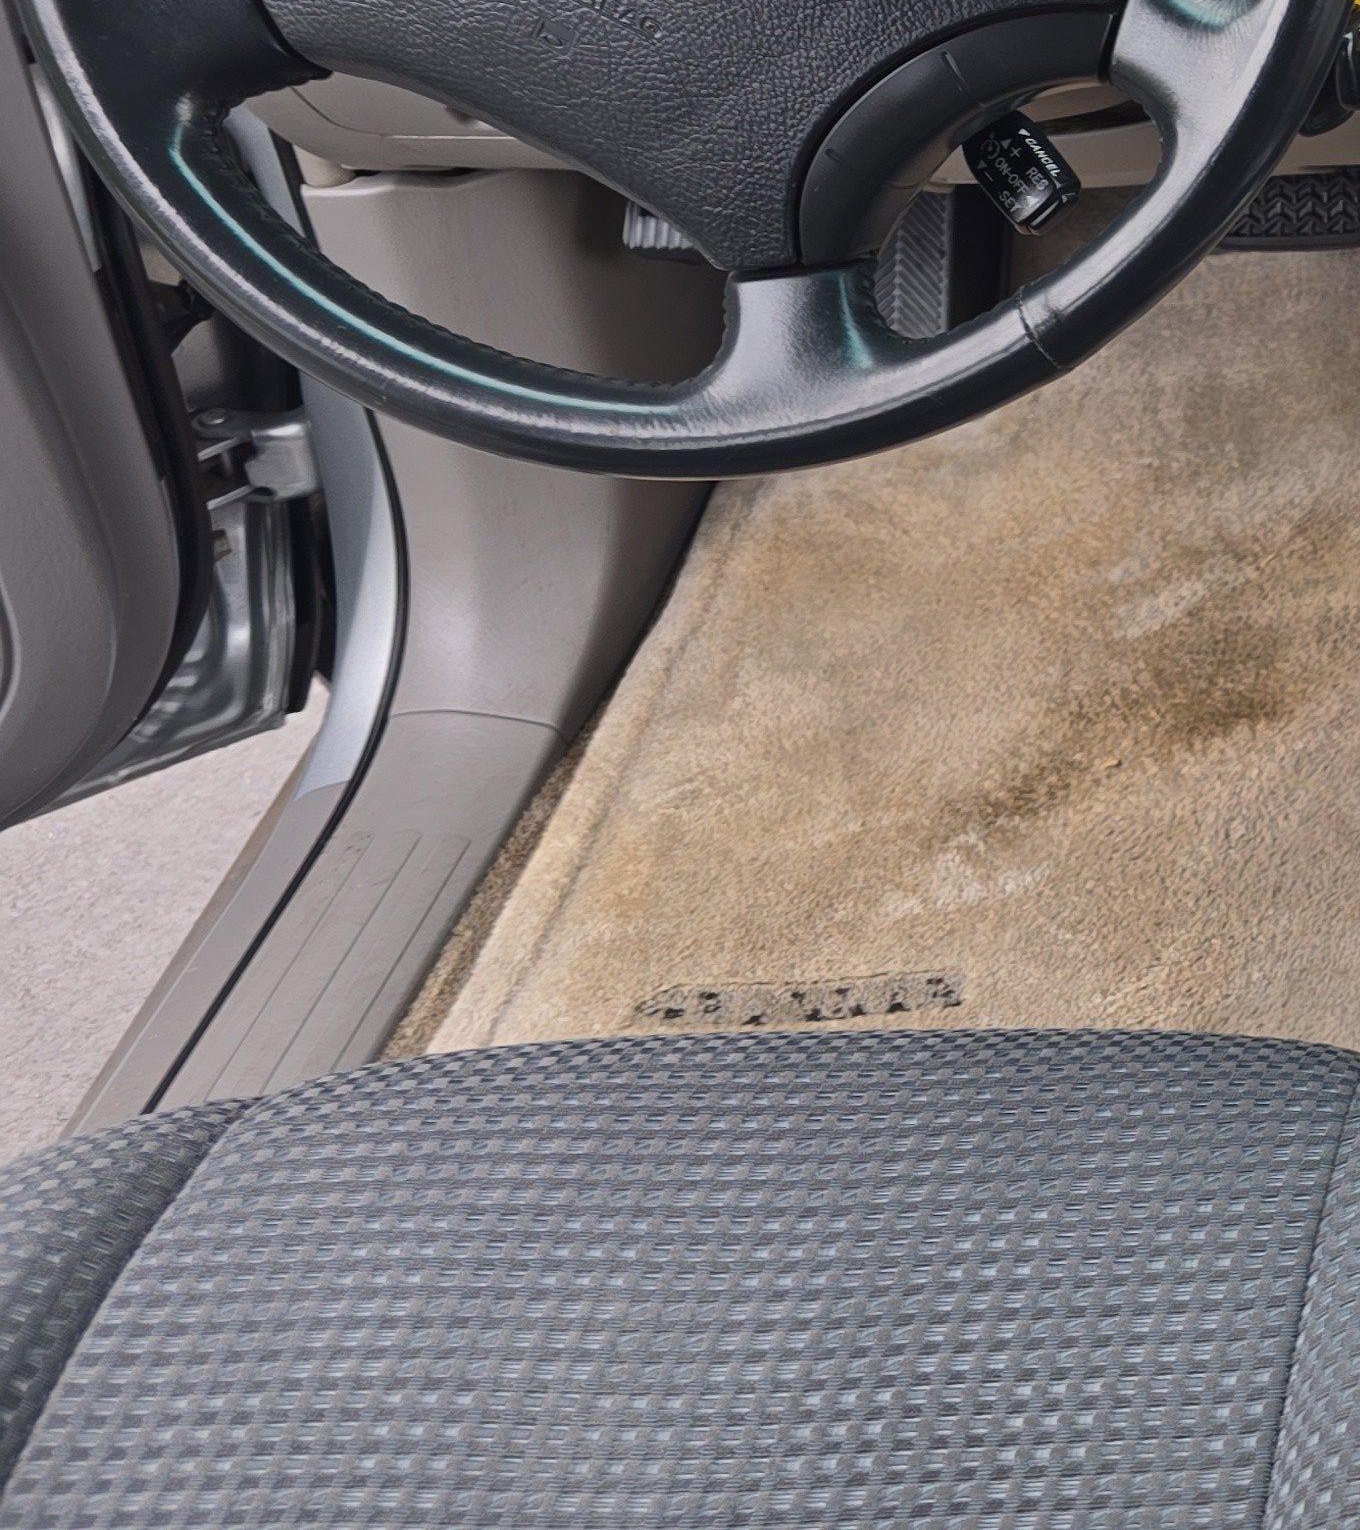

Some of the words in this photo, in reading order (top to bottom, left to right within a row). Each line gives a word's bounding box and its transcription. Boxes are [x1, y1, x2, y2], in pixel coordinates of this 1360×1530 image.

[1025, 138, 1061, 178] CANCEL
[994, 157, 1030, 196] ON-OFF
[1025, 166, 1050, 191] RES
[999, 190, 1024, 213] SET
